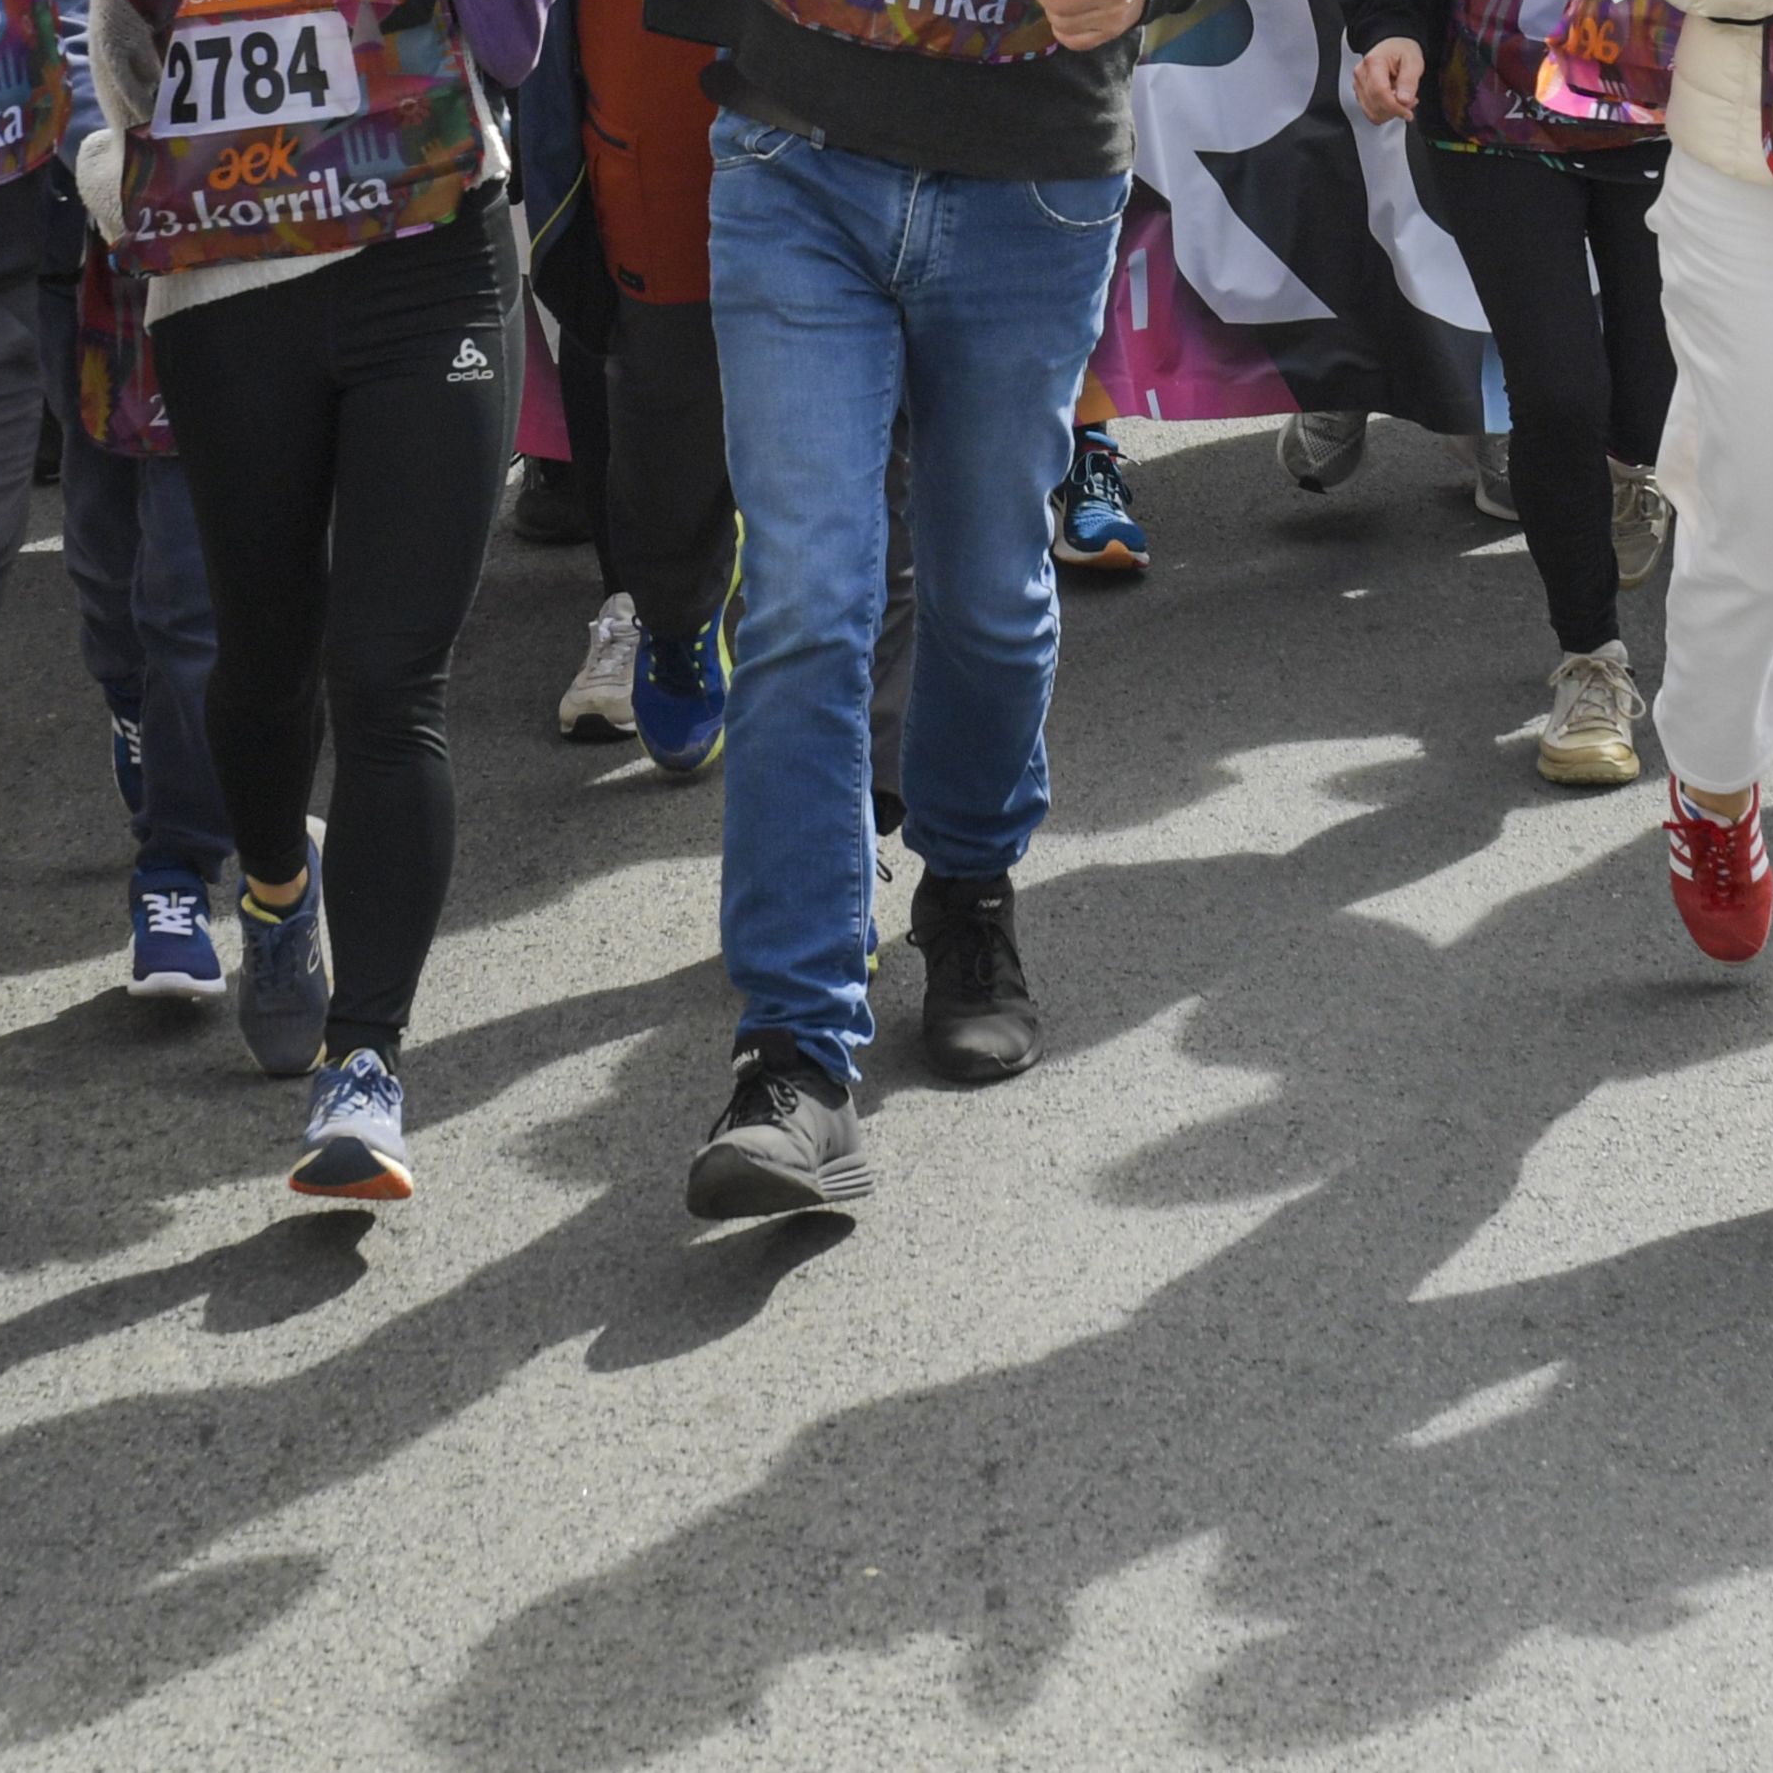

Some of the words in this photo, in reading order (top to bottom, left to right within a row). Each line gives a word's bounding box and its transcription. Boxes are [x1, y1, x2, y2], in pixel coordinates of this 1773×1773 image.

[168, 23, 329, 125] 2784
[208, 126, 299, 190] aek
[134, 167, 392, 242] 23.korrika
[446, 368, 495, 382] odlo
